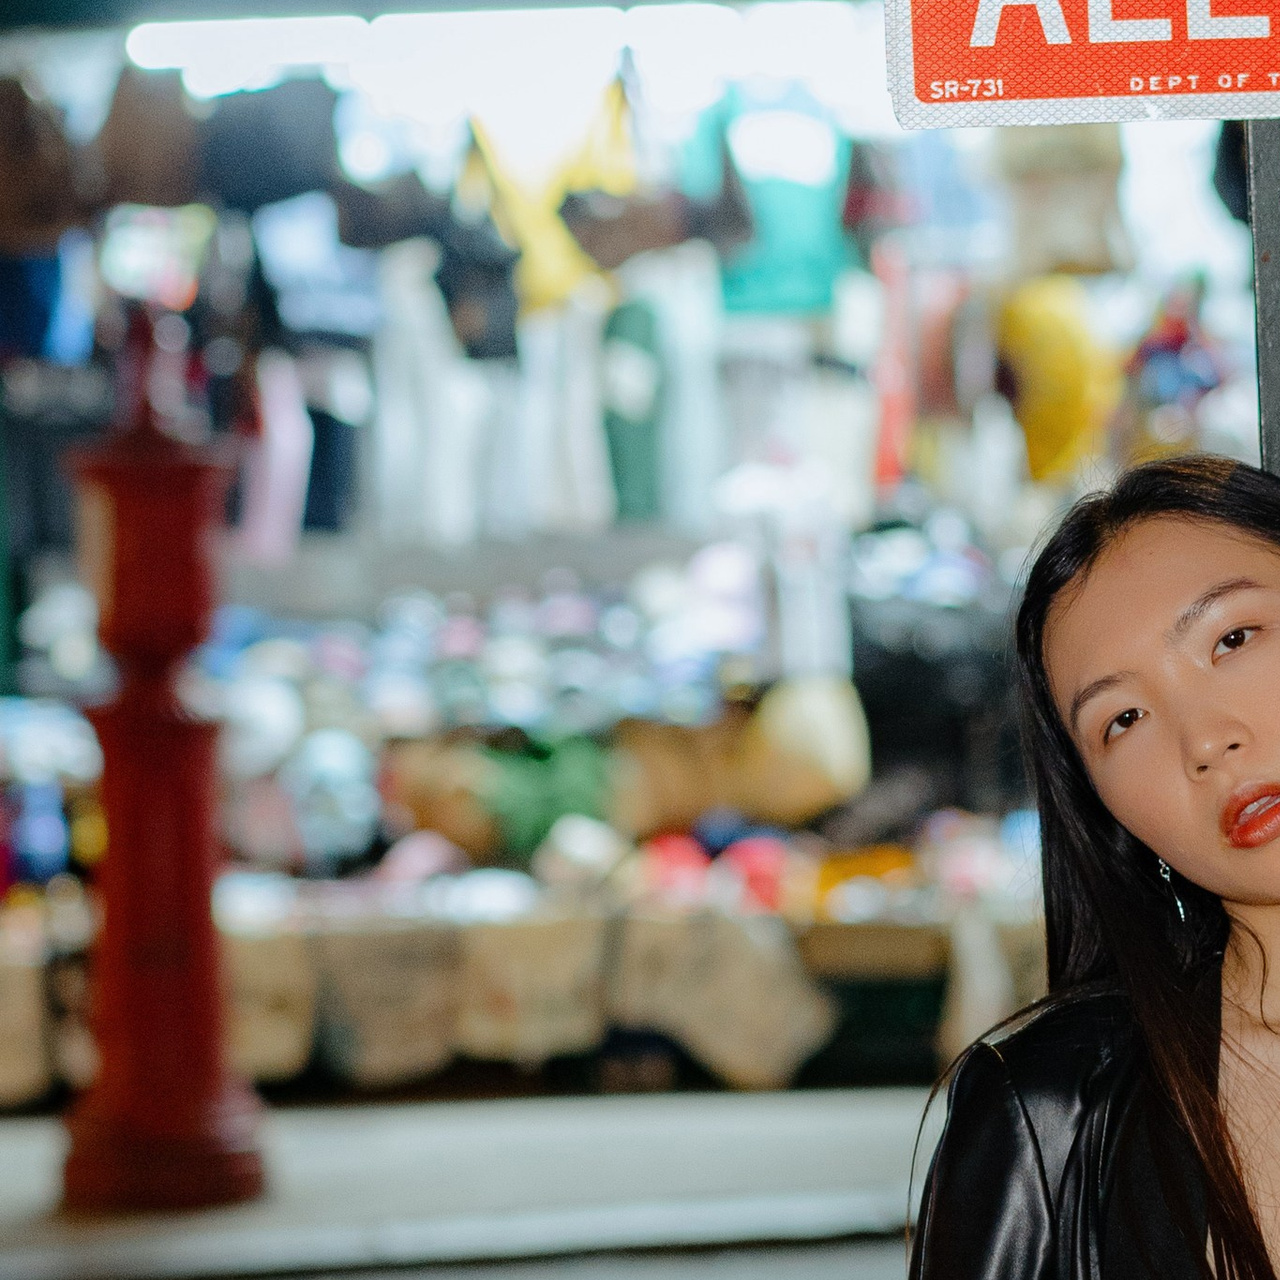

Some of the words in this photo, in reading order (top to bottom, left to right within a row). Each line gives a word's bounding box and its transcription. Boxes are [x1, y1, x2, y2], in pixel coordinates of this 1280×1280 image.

[929, 78, 1005, 100] SR-731
[1129, 74, 1200, 92] DEPT
[1217, 73, 1251, 89] OF
